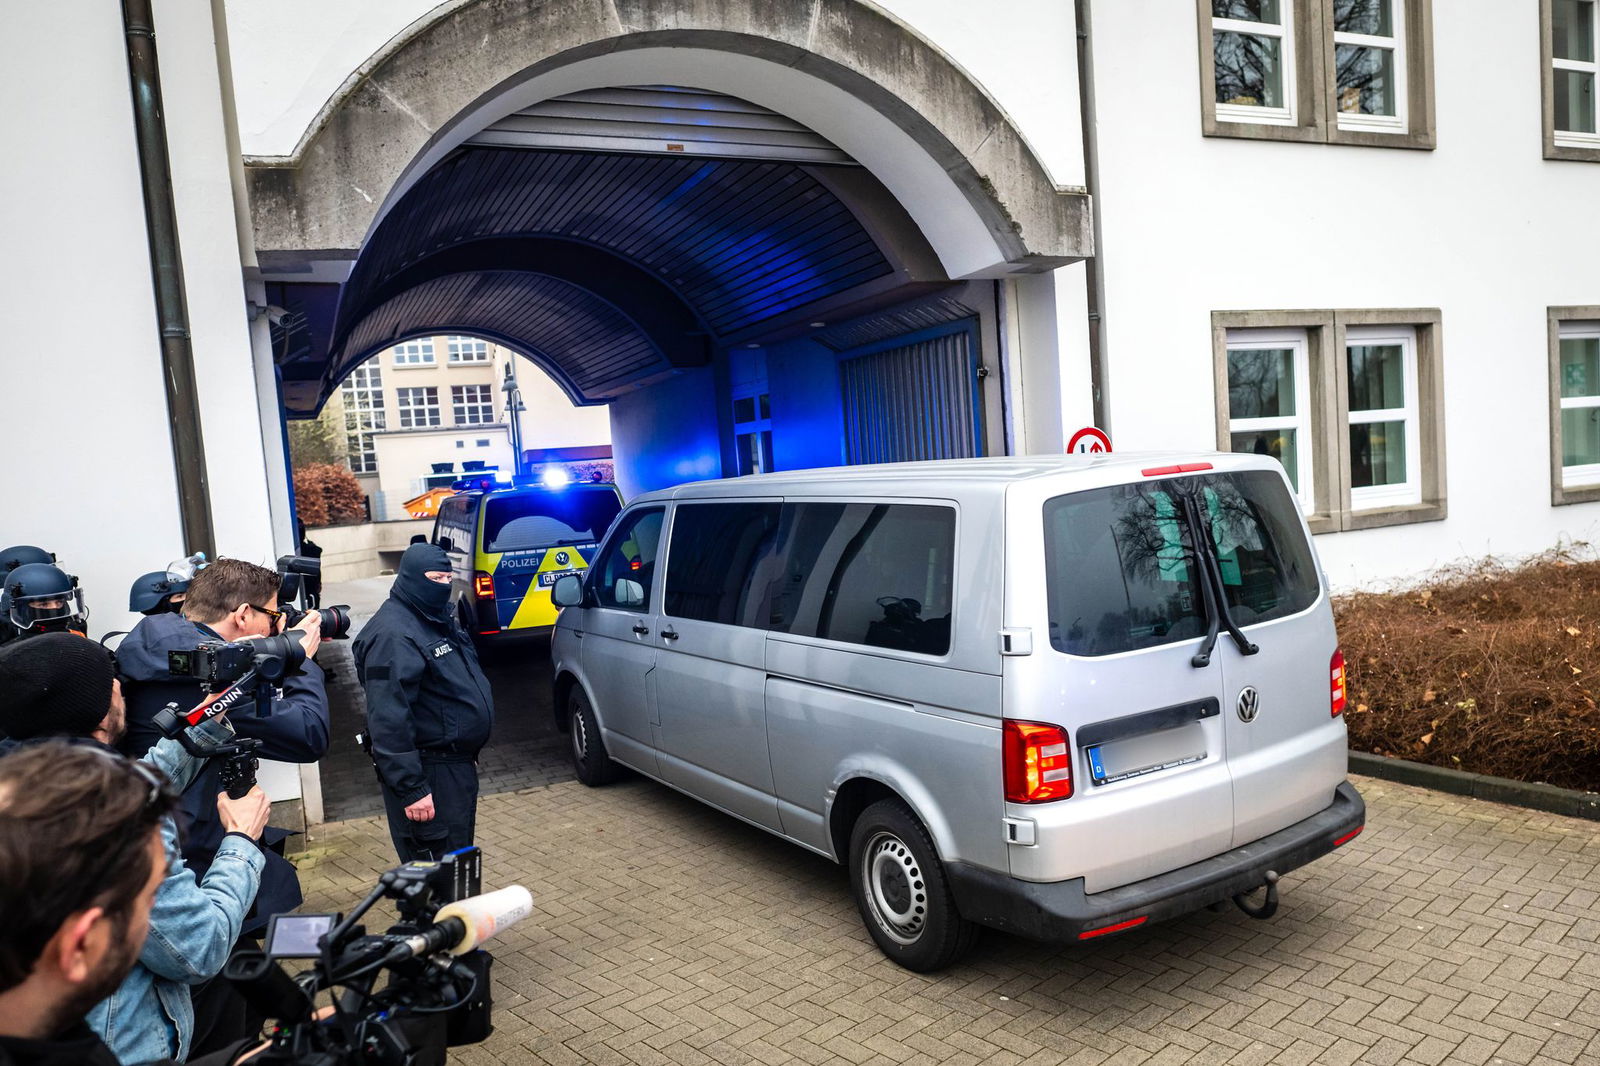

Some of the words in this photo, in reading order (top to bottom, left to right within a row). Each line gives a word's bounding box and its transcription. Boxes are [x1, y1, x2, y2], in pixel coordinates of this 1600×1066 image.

[501, 557, 539, 568] POLIZEI
[204, 687, 243, 717] RONIN
[1238, 687, 1259, 722] VW
